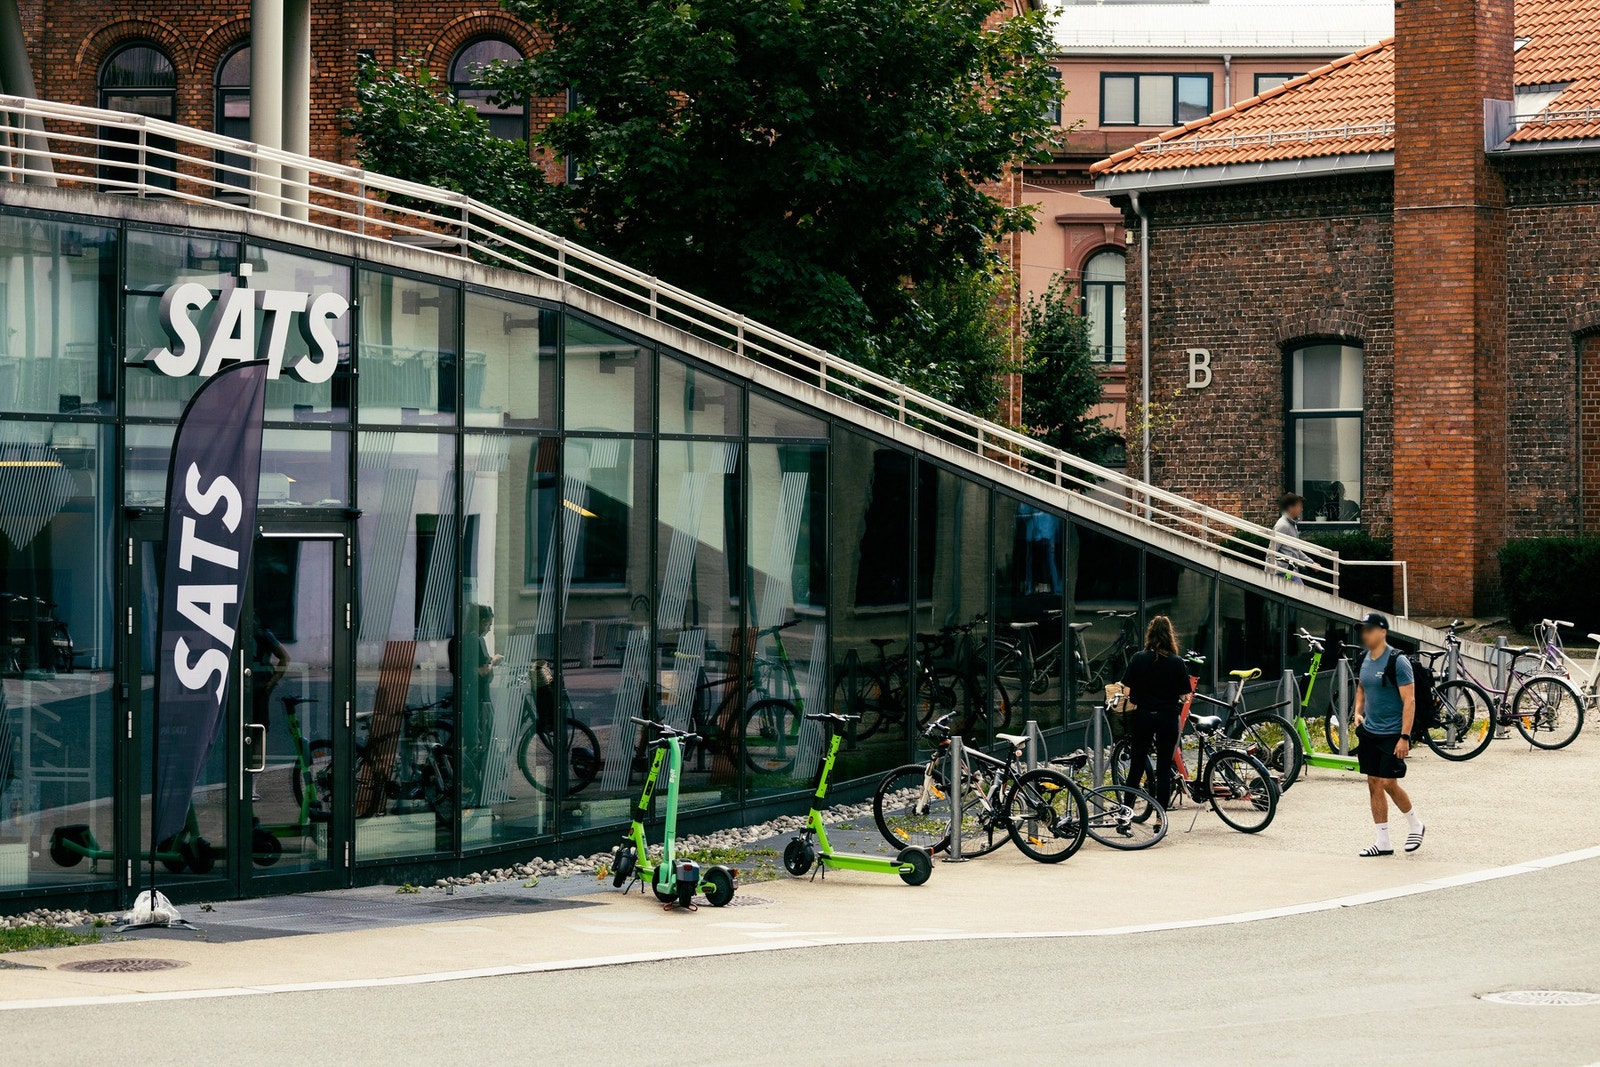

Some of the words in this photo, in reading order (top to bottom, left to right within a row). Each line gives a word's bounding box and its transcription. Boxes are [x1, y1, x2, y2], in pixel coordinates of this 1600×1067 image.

[150, 281, 350, 384] SATS
[1186, 348, 1212, 389] B
[173, 461, 243, 706] SATS
